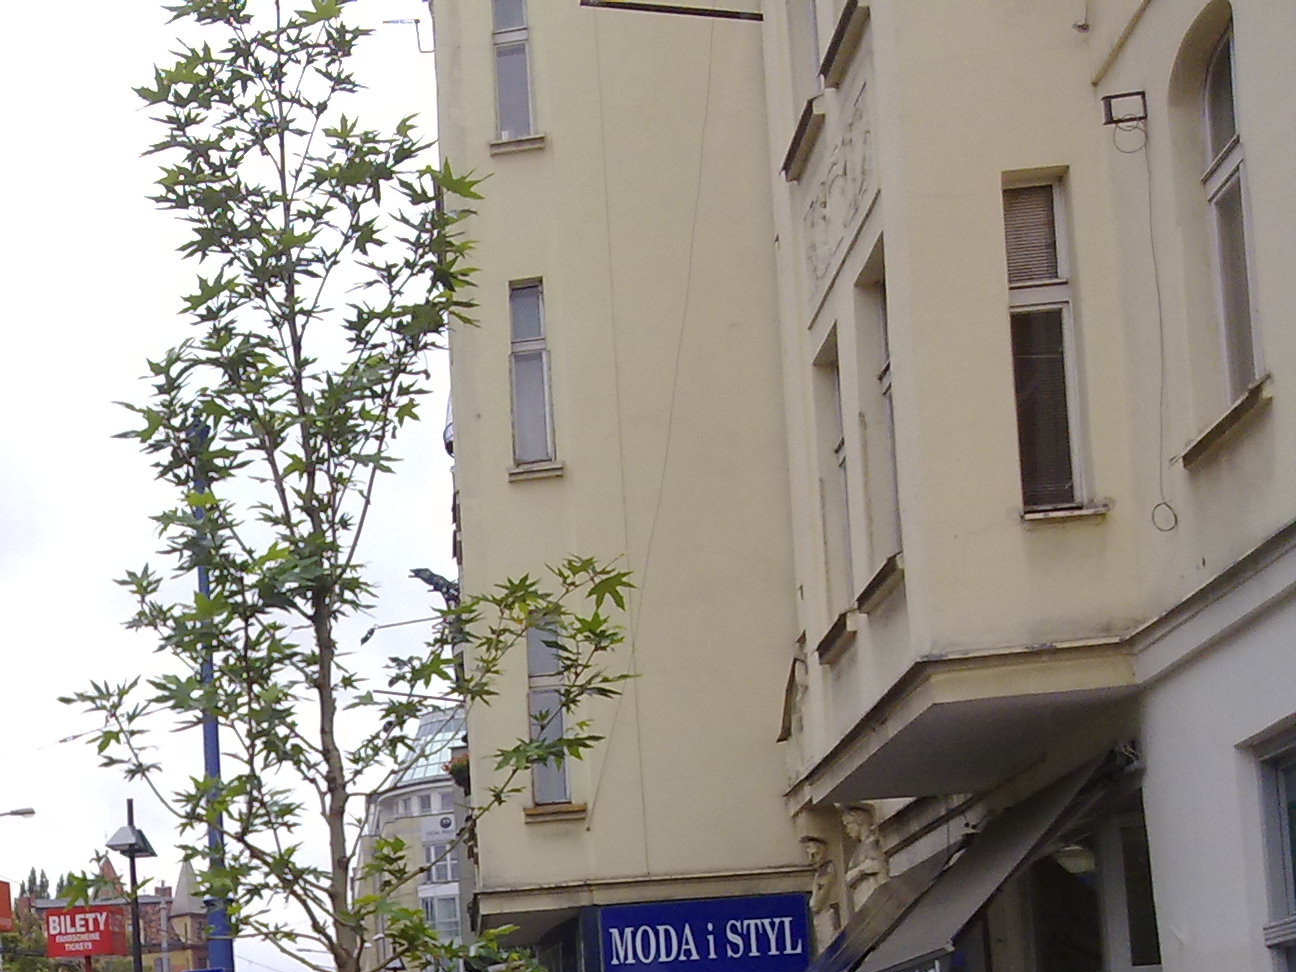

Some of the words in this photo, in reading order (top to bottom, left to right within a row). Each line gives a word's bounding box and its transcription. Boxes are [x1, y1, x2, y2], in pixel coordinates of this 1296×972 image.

[48, 911, 107, 935] BILETY
[609, 923, 700, 966] MODA
[706, 922, 718, 960] i
[726, 916, 803, 959] STYL
